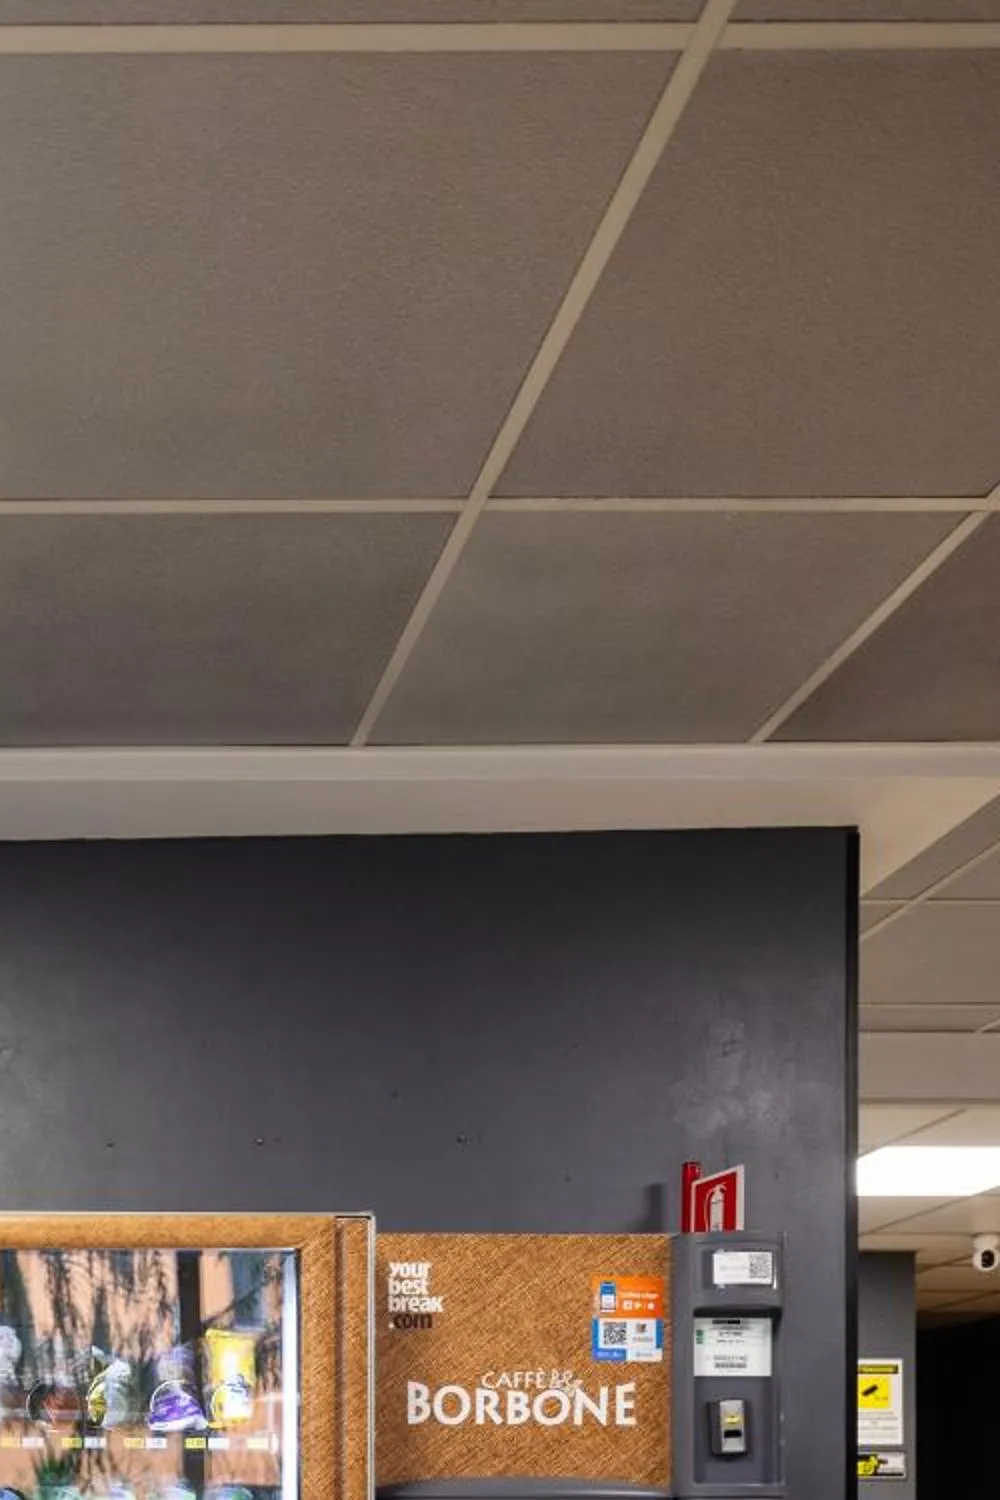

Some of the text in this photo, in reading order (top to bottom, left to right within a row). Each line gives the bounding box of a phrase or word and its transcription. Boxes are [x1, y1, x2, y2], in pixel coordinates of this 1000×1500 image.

[389, 1261, 432, 1278] your
[388, 1278, 429, 1295] best
[388, 1295, 444, 1313] break
[481, 1368, 545, 1389] CAFFÈ
[407, 1381, 637, 1426] BORBONE
